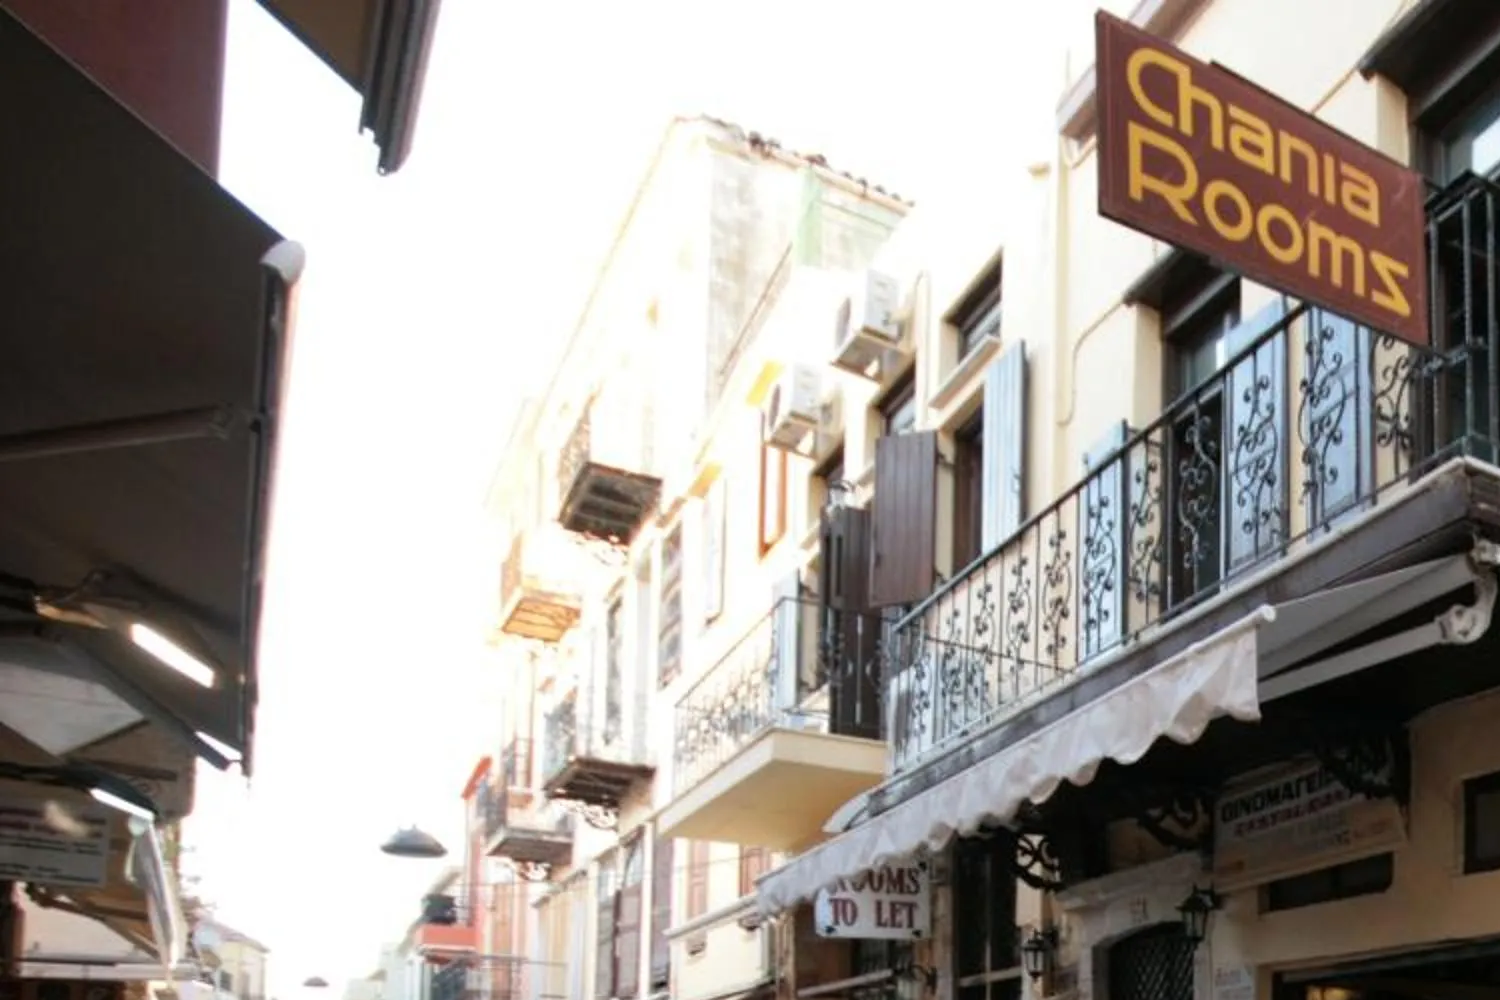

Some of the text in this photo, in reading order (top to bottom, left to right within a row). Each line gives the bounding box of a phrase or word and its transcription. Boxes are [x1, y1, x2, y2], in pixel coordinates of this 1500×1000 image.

[1126, 47, 1380, 227] Chania
[1127, 121, 1411, 318] Rooms
[829, 897, 918, 929] TO LET
